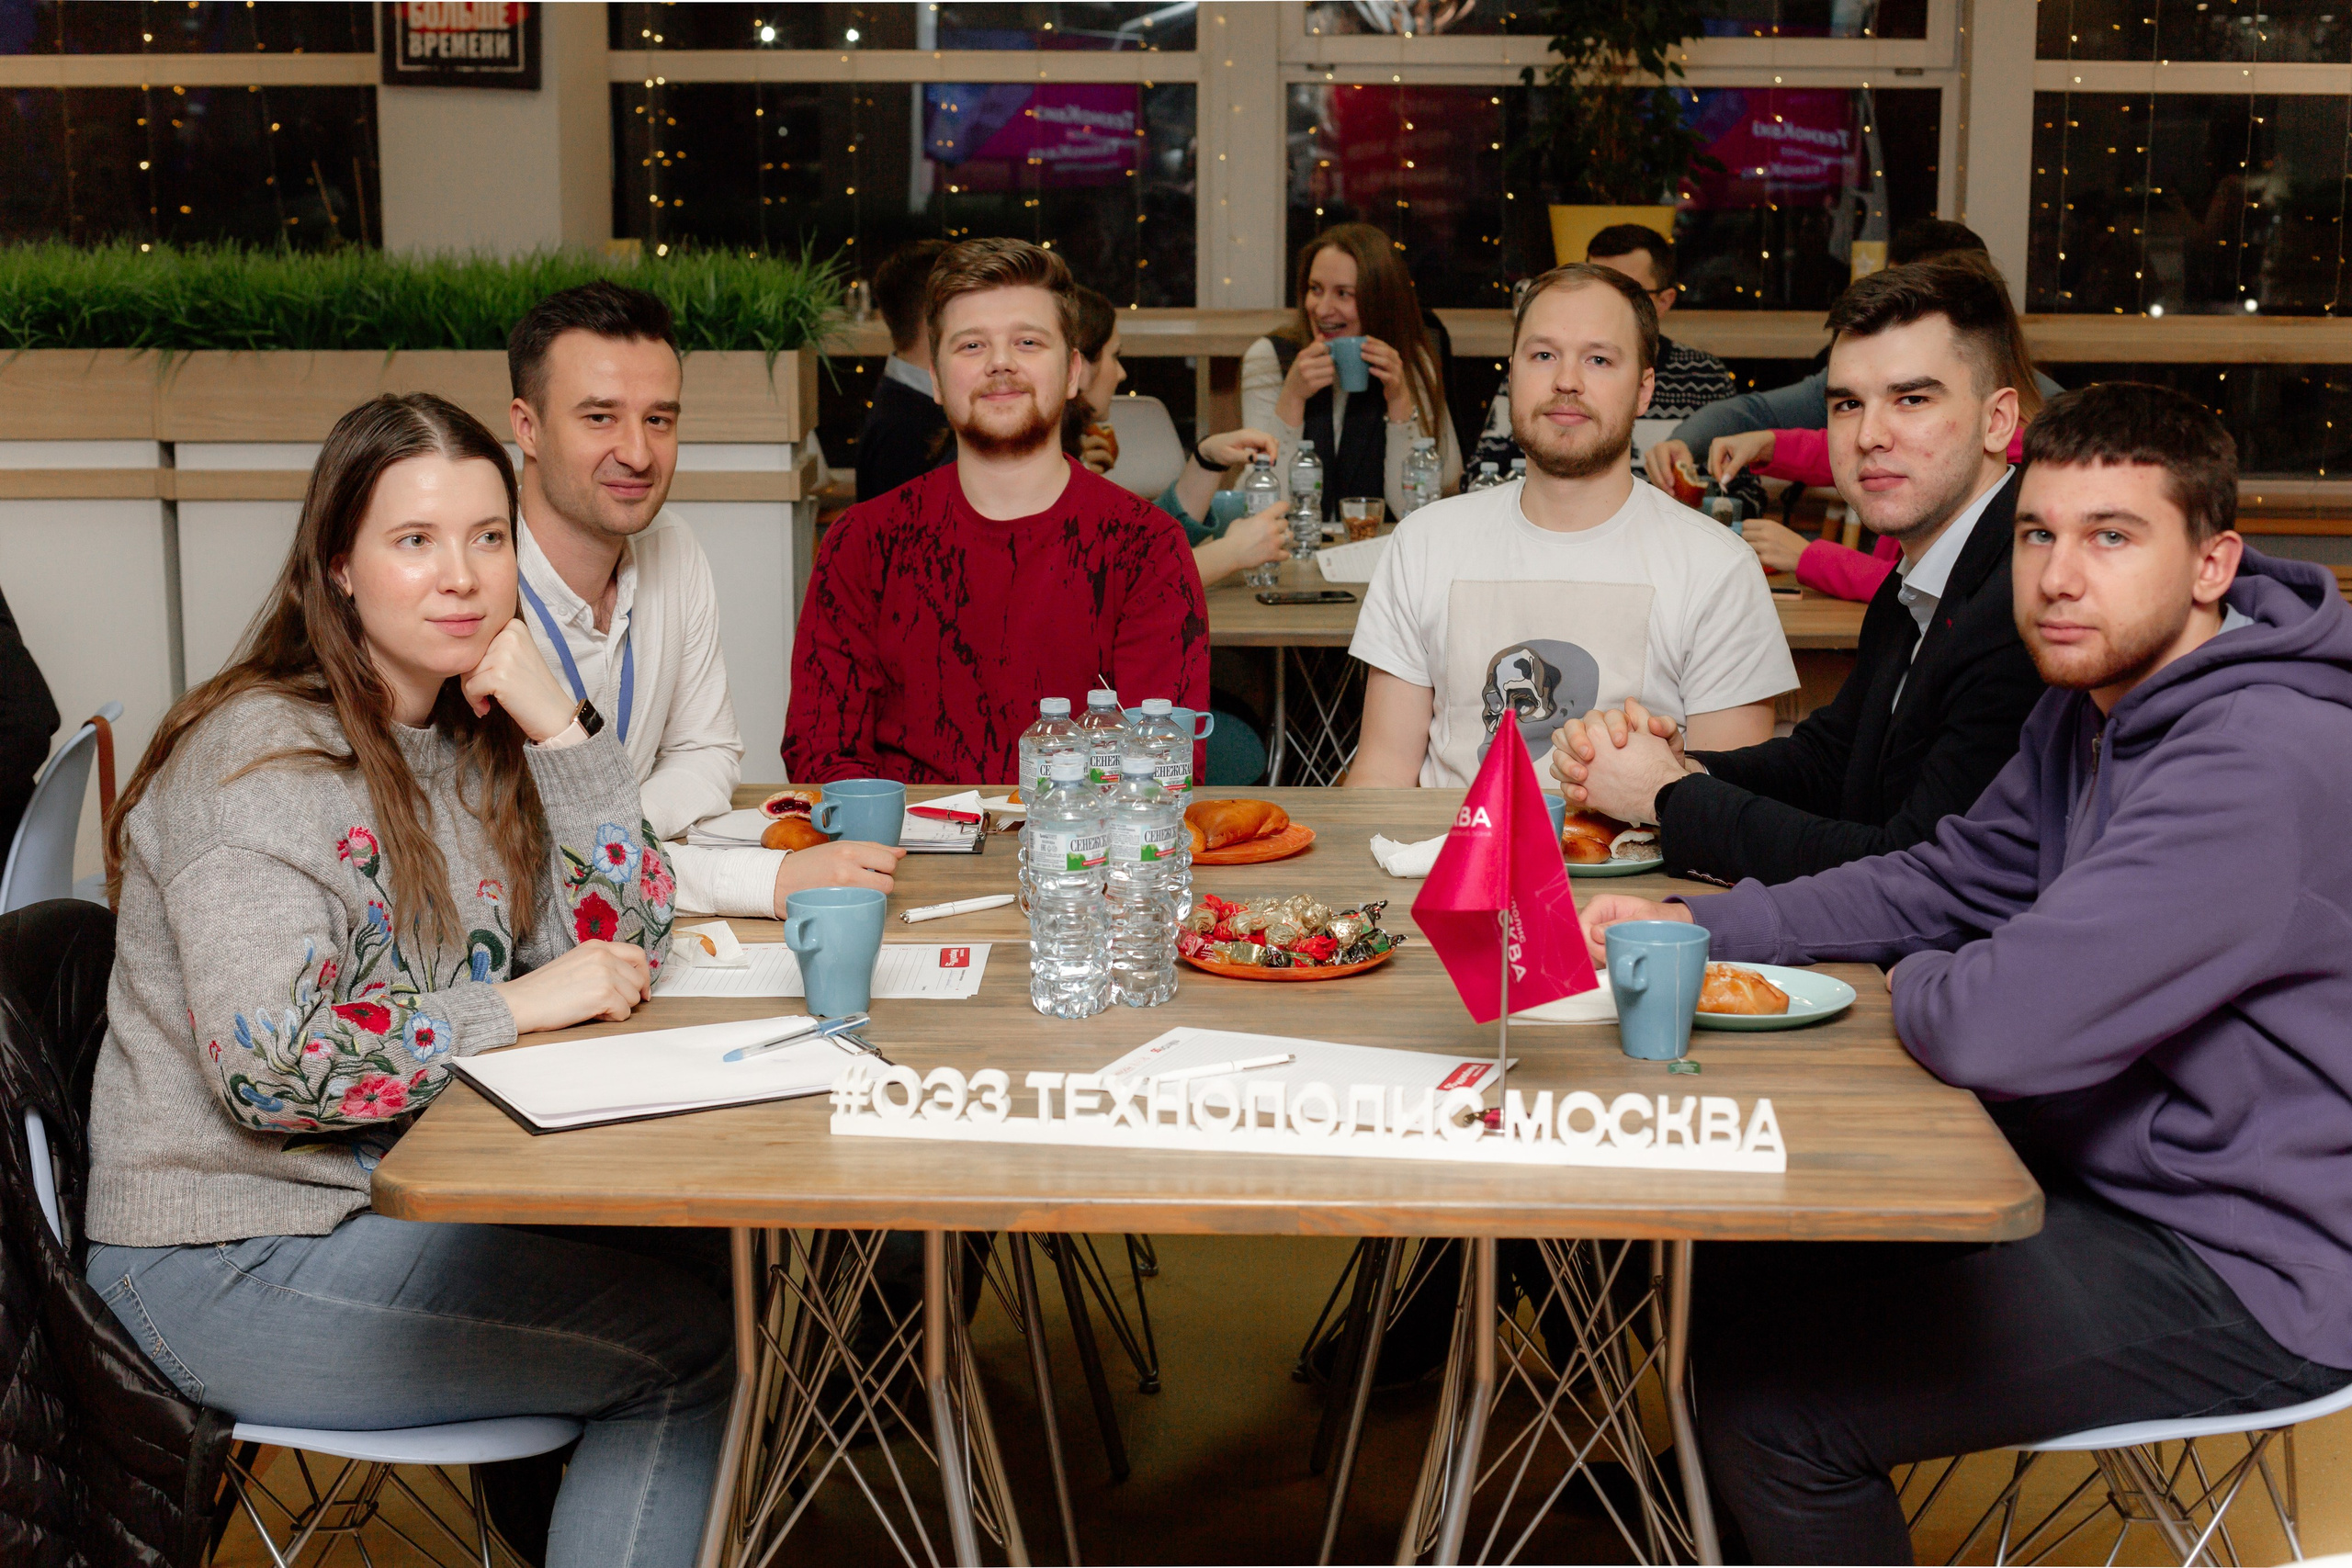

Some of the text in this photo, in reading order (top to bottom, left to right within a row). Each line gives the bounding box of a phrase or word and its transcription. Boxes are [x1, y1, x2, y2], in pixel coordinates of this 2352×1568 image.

[408, 32, 511, 58] ВРЕМЕНИ
[1454, 806, 1492, 829] ВА
[830, 1065, 1786, 1154] #ОЭЗ ТЕХНОПОЛИС МОСКВА
